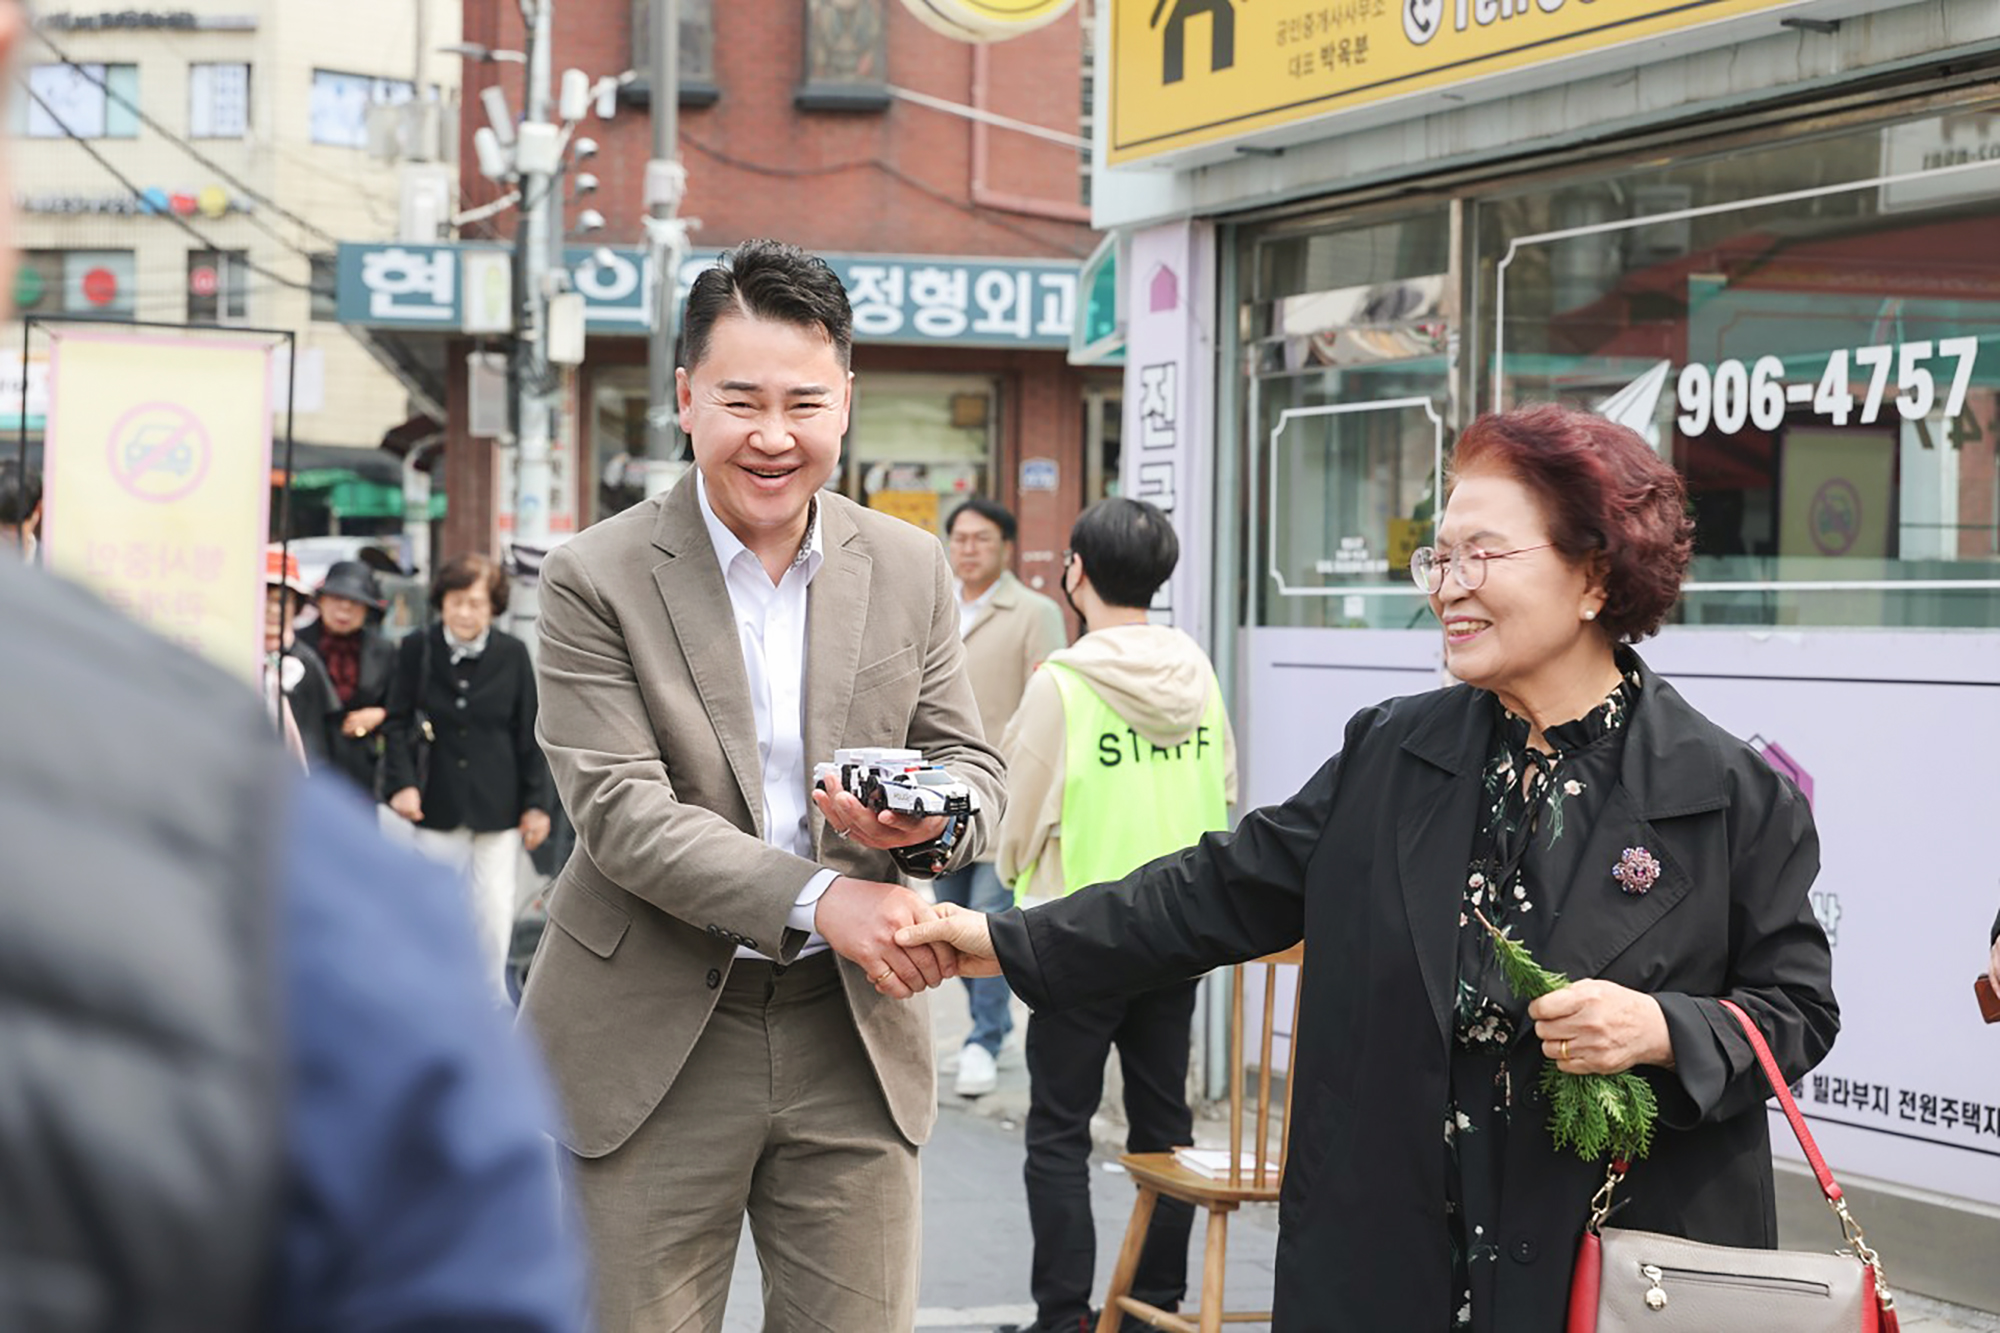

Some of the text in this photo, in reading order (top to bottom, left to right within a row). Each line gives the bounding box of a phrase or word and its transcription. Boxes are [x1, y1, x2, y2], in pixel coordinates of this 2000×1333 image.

[1288, 51, 1315, 78] 대표
[1677, 336, 1978, 437] 906-4757
[1813, 1074, 1889, 1116] 빌라부지
